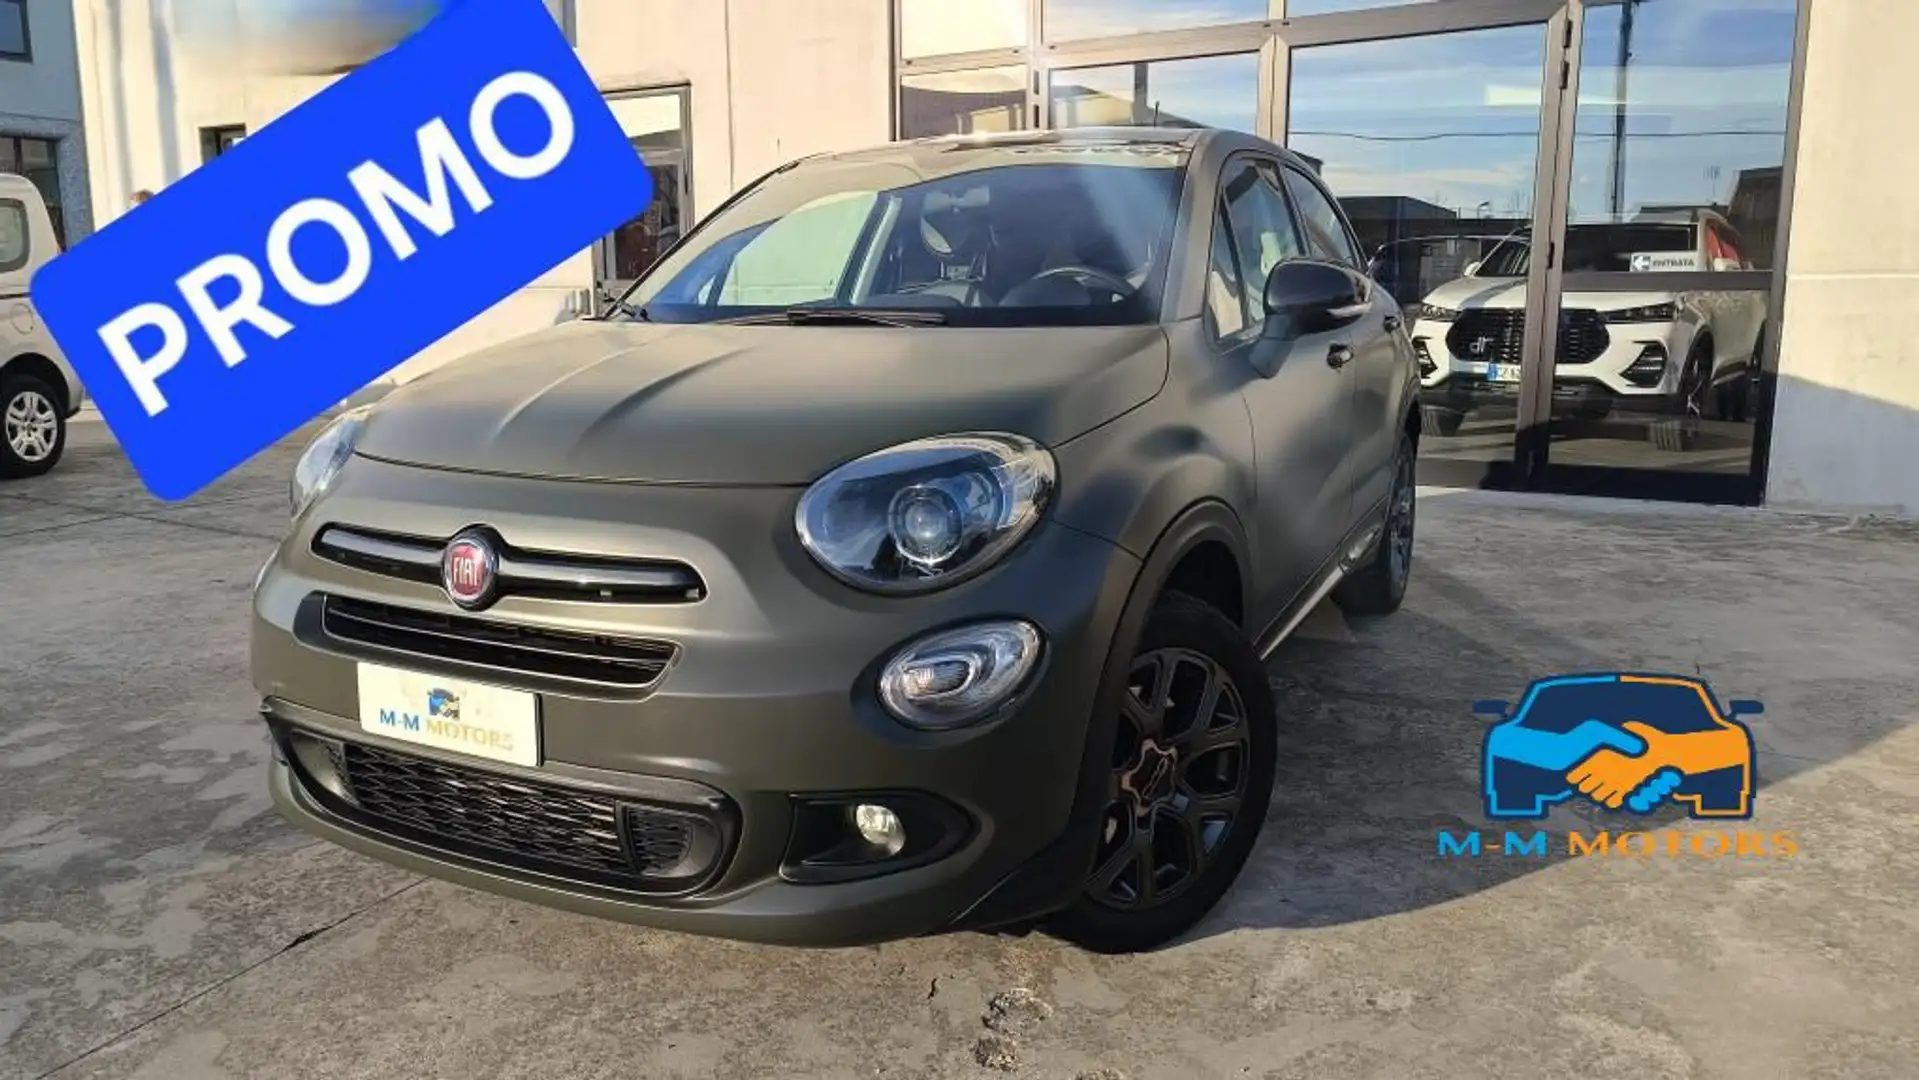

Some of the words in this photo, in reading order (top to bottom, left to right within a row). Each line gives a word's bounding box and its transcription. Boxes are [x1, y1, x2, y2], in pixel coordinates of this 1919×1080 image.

[453, 556, 479, 586] FIAT
[379, 708, 421, 731] M-M
[424, 718, 514, 751] MOTORS
